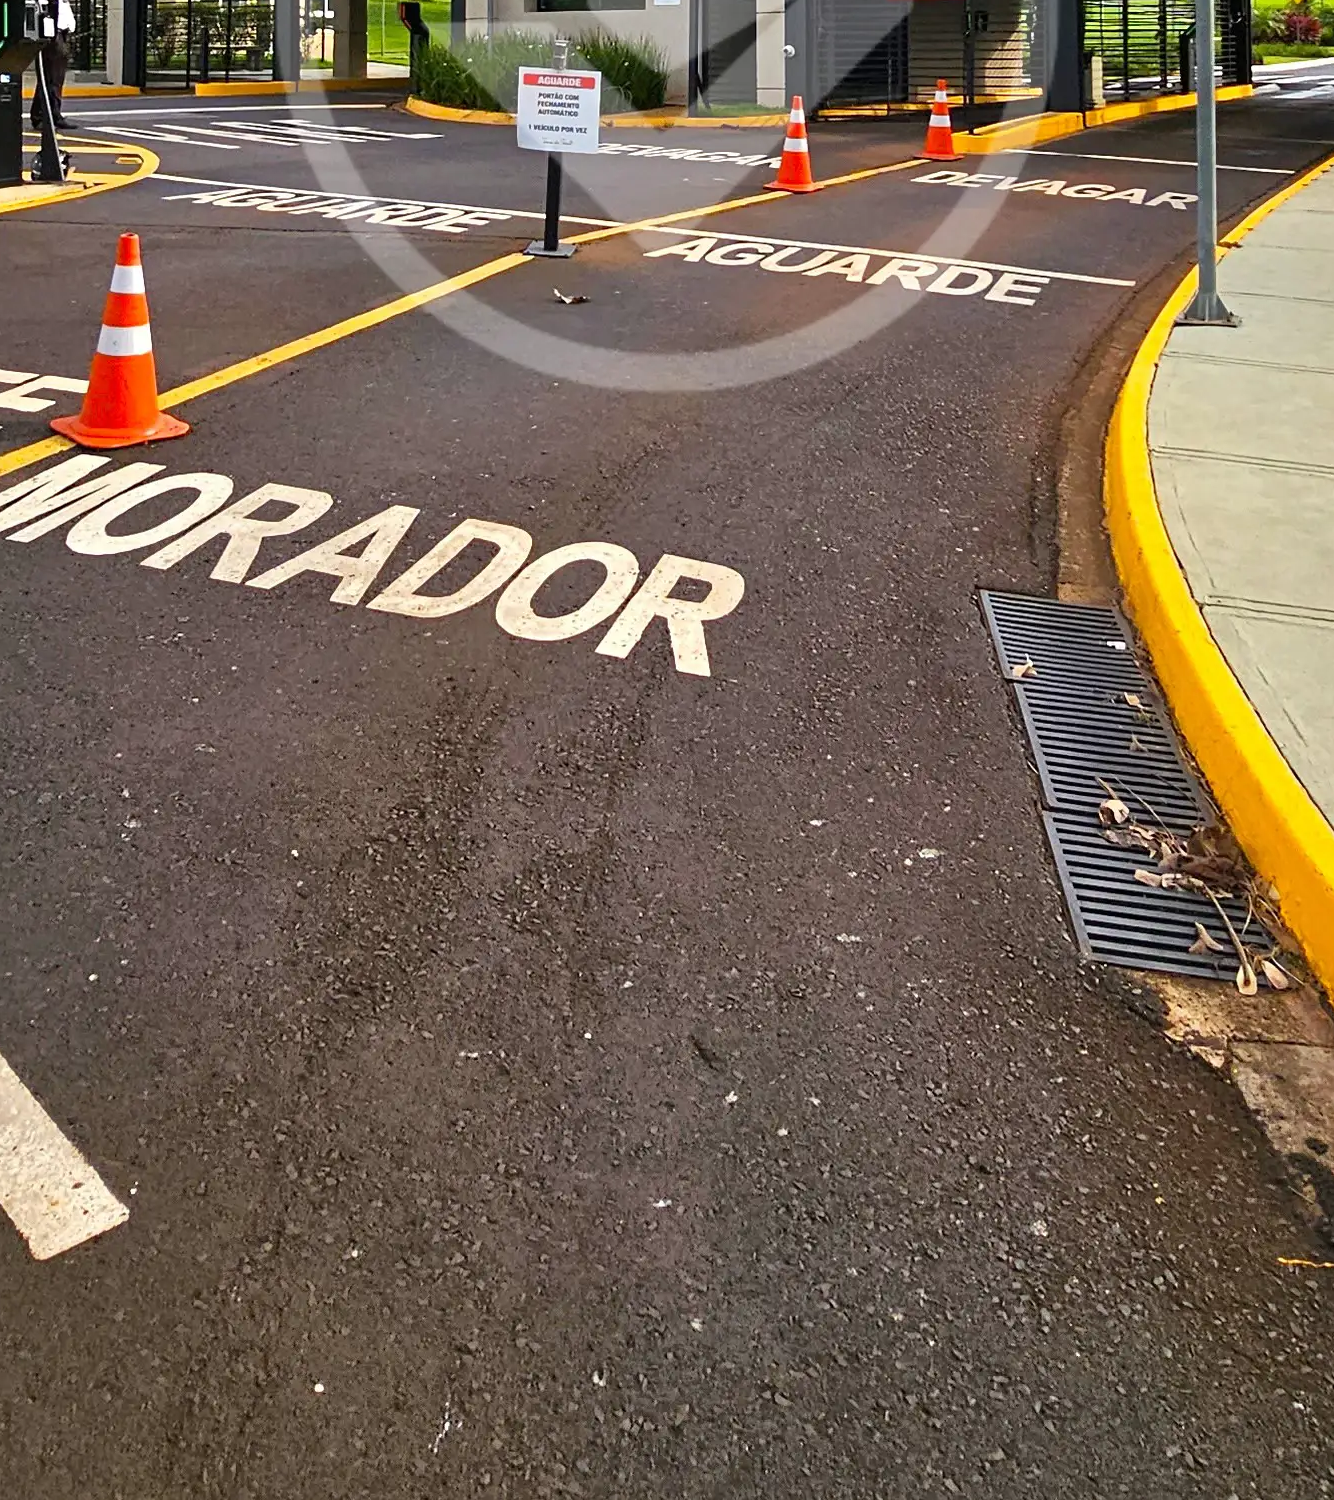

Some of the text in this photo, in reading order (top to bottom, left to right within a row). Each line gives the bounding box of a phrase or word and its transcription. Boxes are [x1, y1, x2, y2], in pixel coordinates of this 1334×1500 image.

[537, 75, 582, 87] AGUARDE
[538, 92, 563, 100] PORTÃO
[537, 100, 580, 109] FECHAMENTO
[538, 108, 579, 117] AUTOMÁTICO
[533, 123, 560, 132] VEÍCULO
[83, 119, 445, 149] PARE
[910, 170, 1199, 210] DEVAGAR
[162, 188, 512, 233] AGUARDE
[643, 236, 1051, 306] AGUARDE
